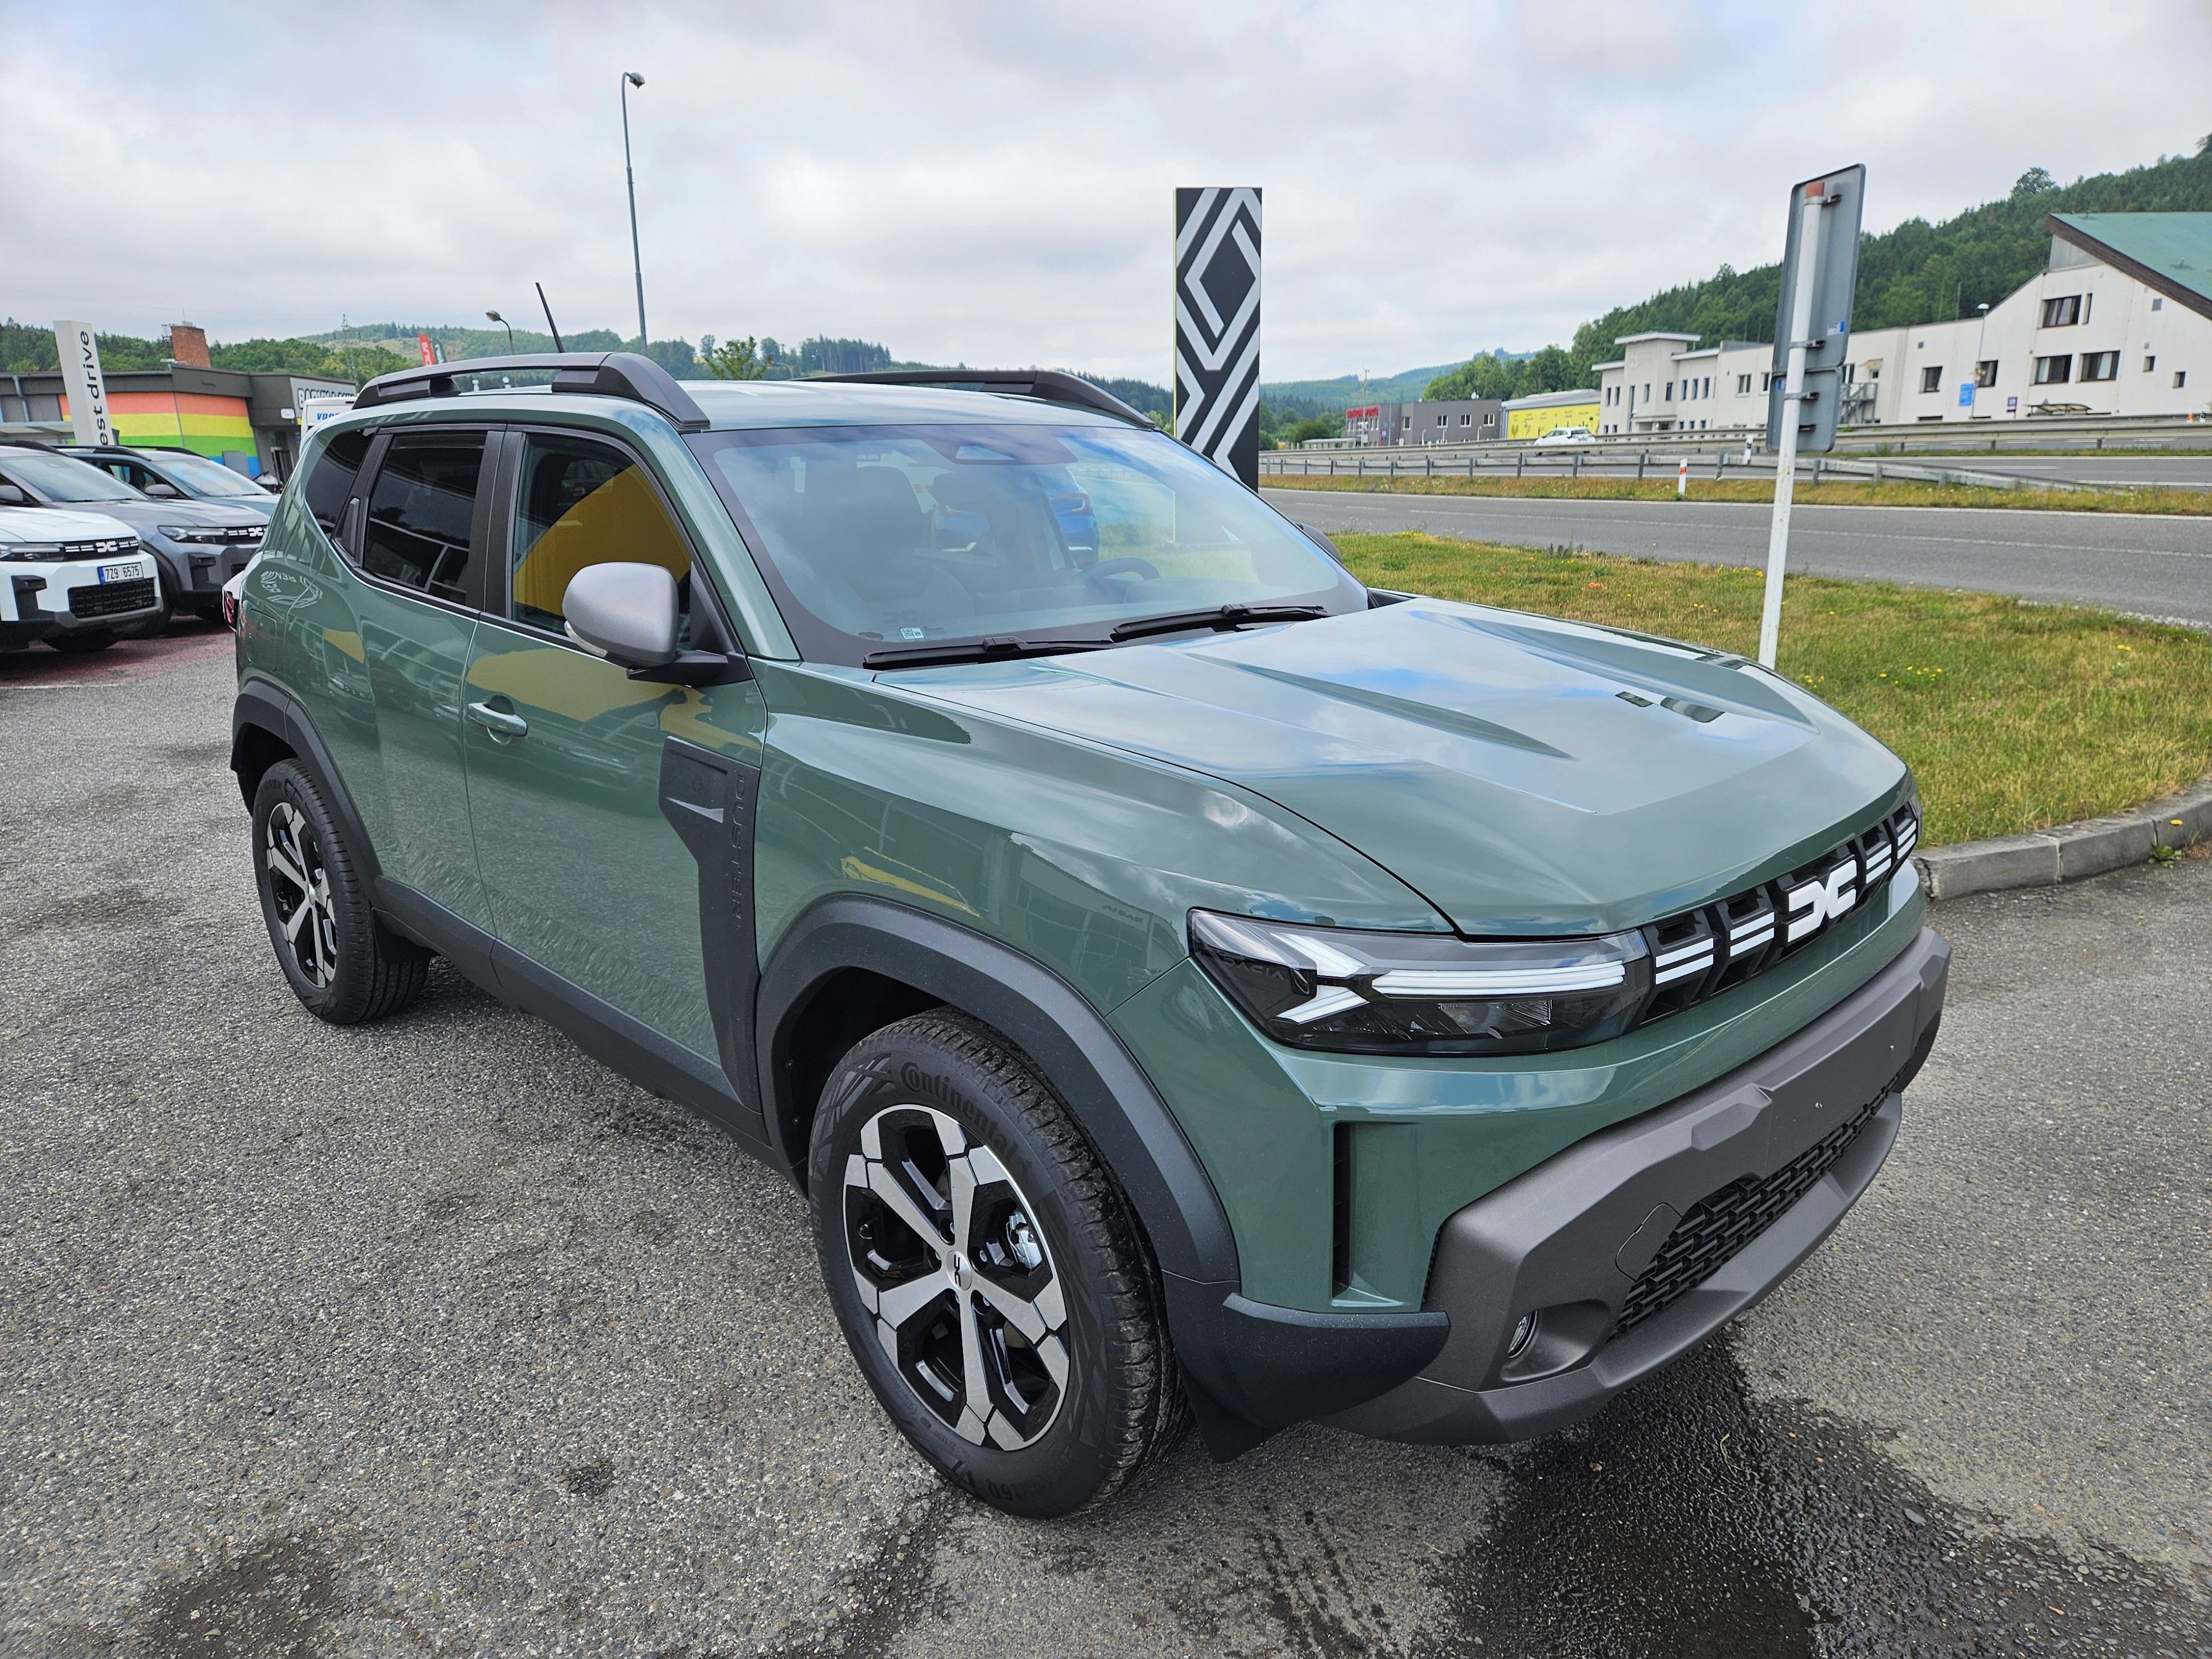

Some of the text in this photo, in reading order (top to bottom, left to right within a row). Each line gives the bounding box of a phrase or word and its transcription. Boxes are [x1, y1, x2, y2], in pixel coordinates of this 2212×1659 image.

[80, 331, 108, 446] est drive
[105, 565, 139, 580] 7Z9 6575
[900, 1061, 1020, 1161] Continental
